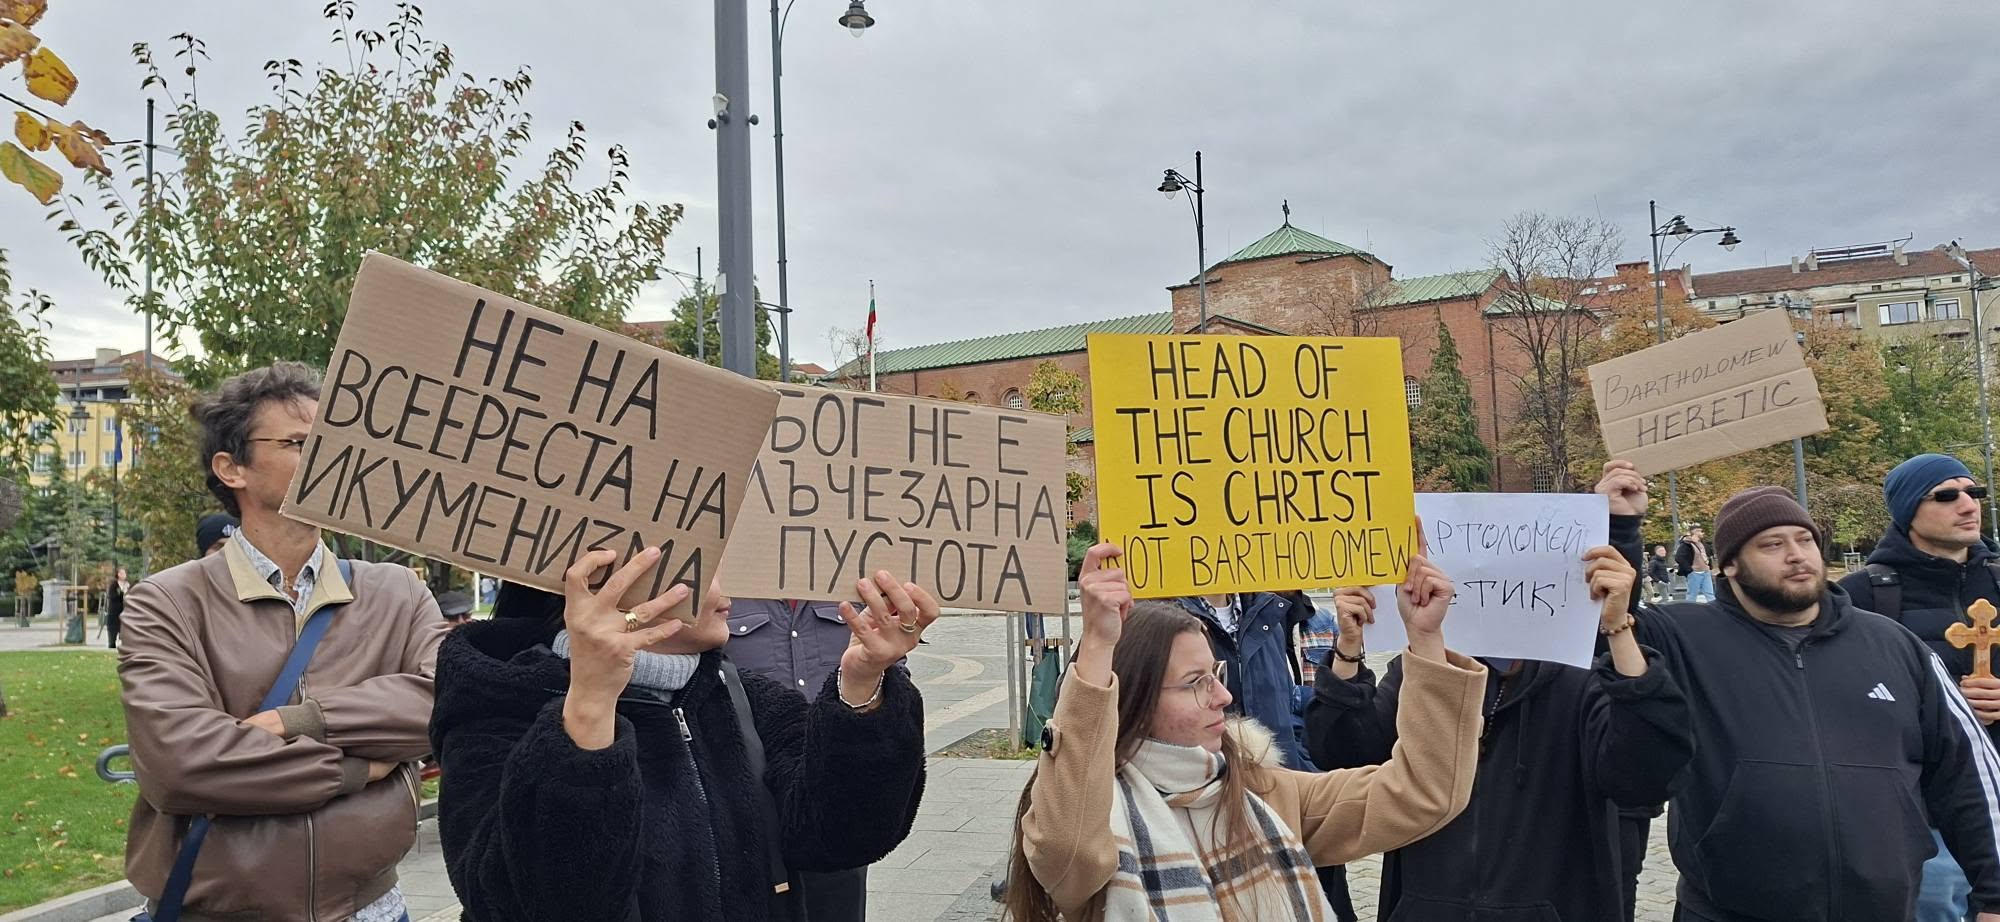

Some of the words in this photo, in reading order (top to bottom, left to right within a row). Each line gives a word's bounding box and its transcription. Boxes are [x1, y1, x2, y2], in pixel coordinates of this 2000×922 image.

[453, 298, 564, 402] НЕ
[568, 339, 660, 440] НА
[1148, 340, 1267, 400] HEAD
[1294, 343, 1344, 400] OF
[324, 348, 634, 512] ВСЕЕРЕСТА
[651, 458, 727, 539] НА
[770, 388, 886, 459] БОГ
[908, 404, 971, 469] НЕ
[997, 414, 1029, 476] Е
[1115, 406, 1212, 465] THE
[1223, 406, 1371, 464] CHURCH
[1637, 379, 1801, 448] HERETIC
[748, 459, 1061, 545] ЛЪЧЕЗАРНА
[1135, 470, 1198, 529] IS
[1223, 469, 1381, 527] CHRIST
[778, 525, 1032, 606] ПУСТОТА
[1190, 525, 1412, 587] BARTHOLOMEW
[1425, 518, 1586, 556] РТОЛОМЕЙ
[1395, 571, 1569, 617] ТИК!
